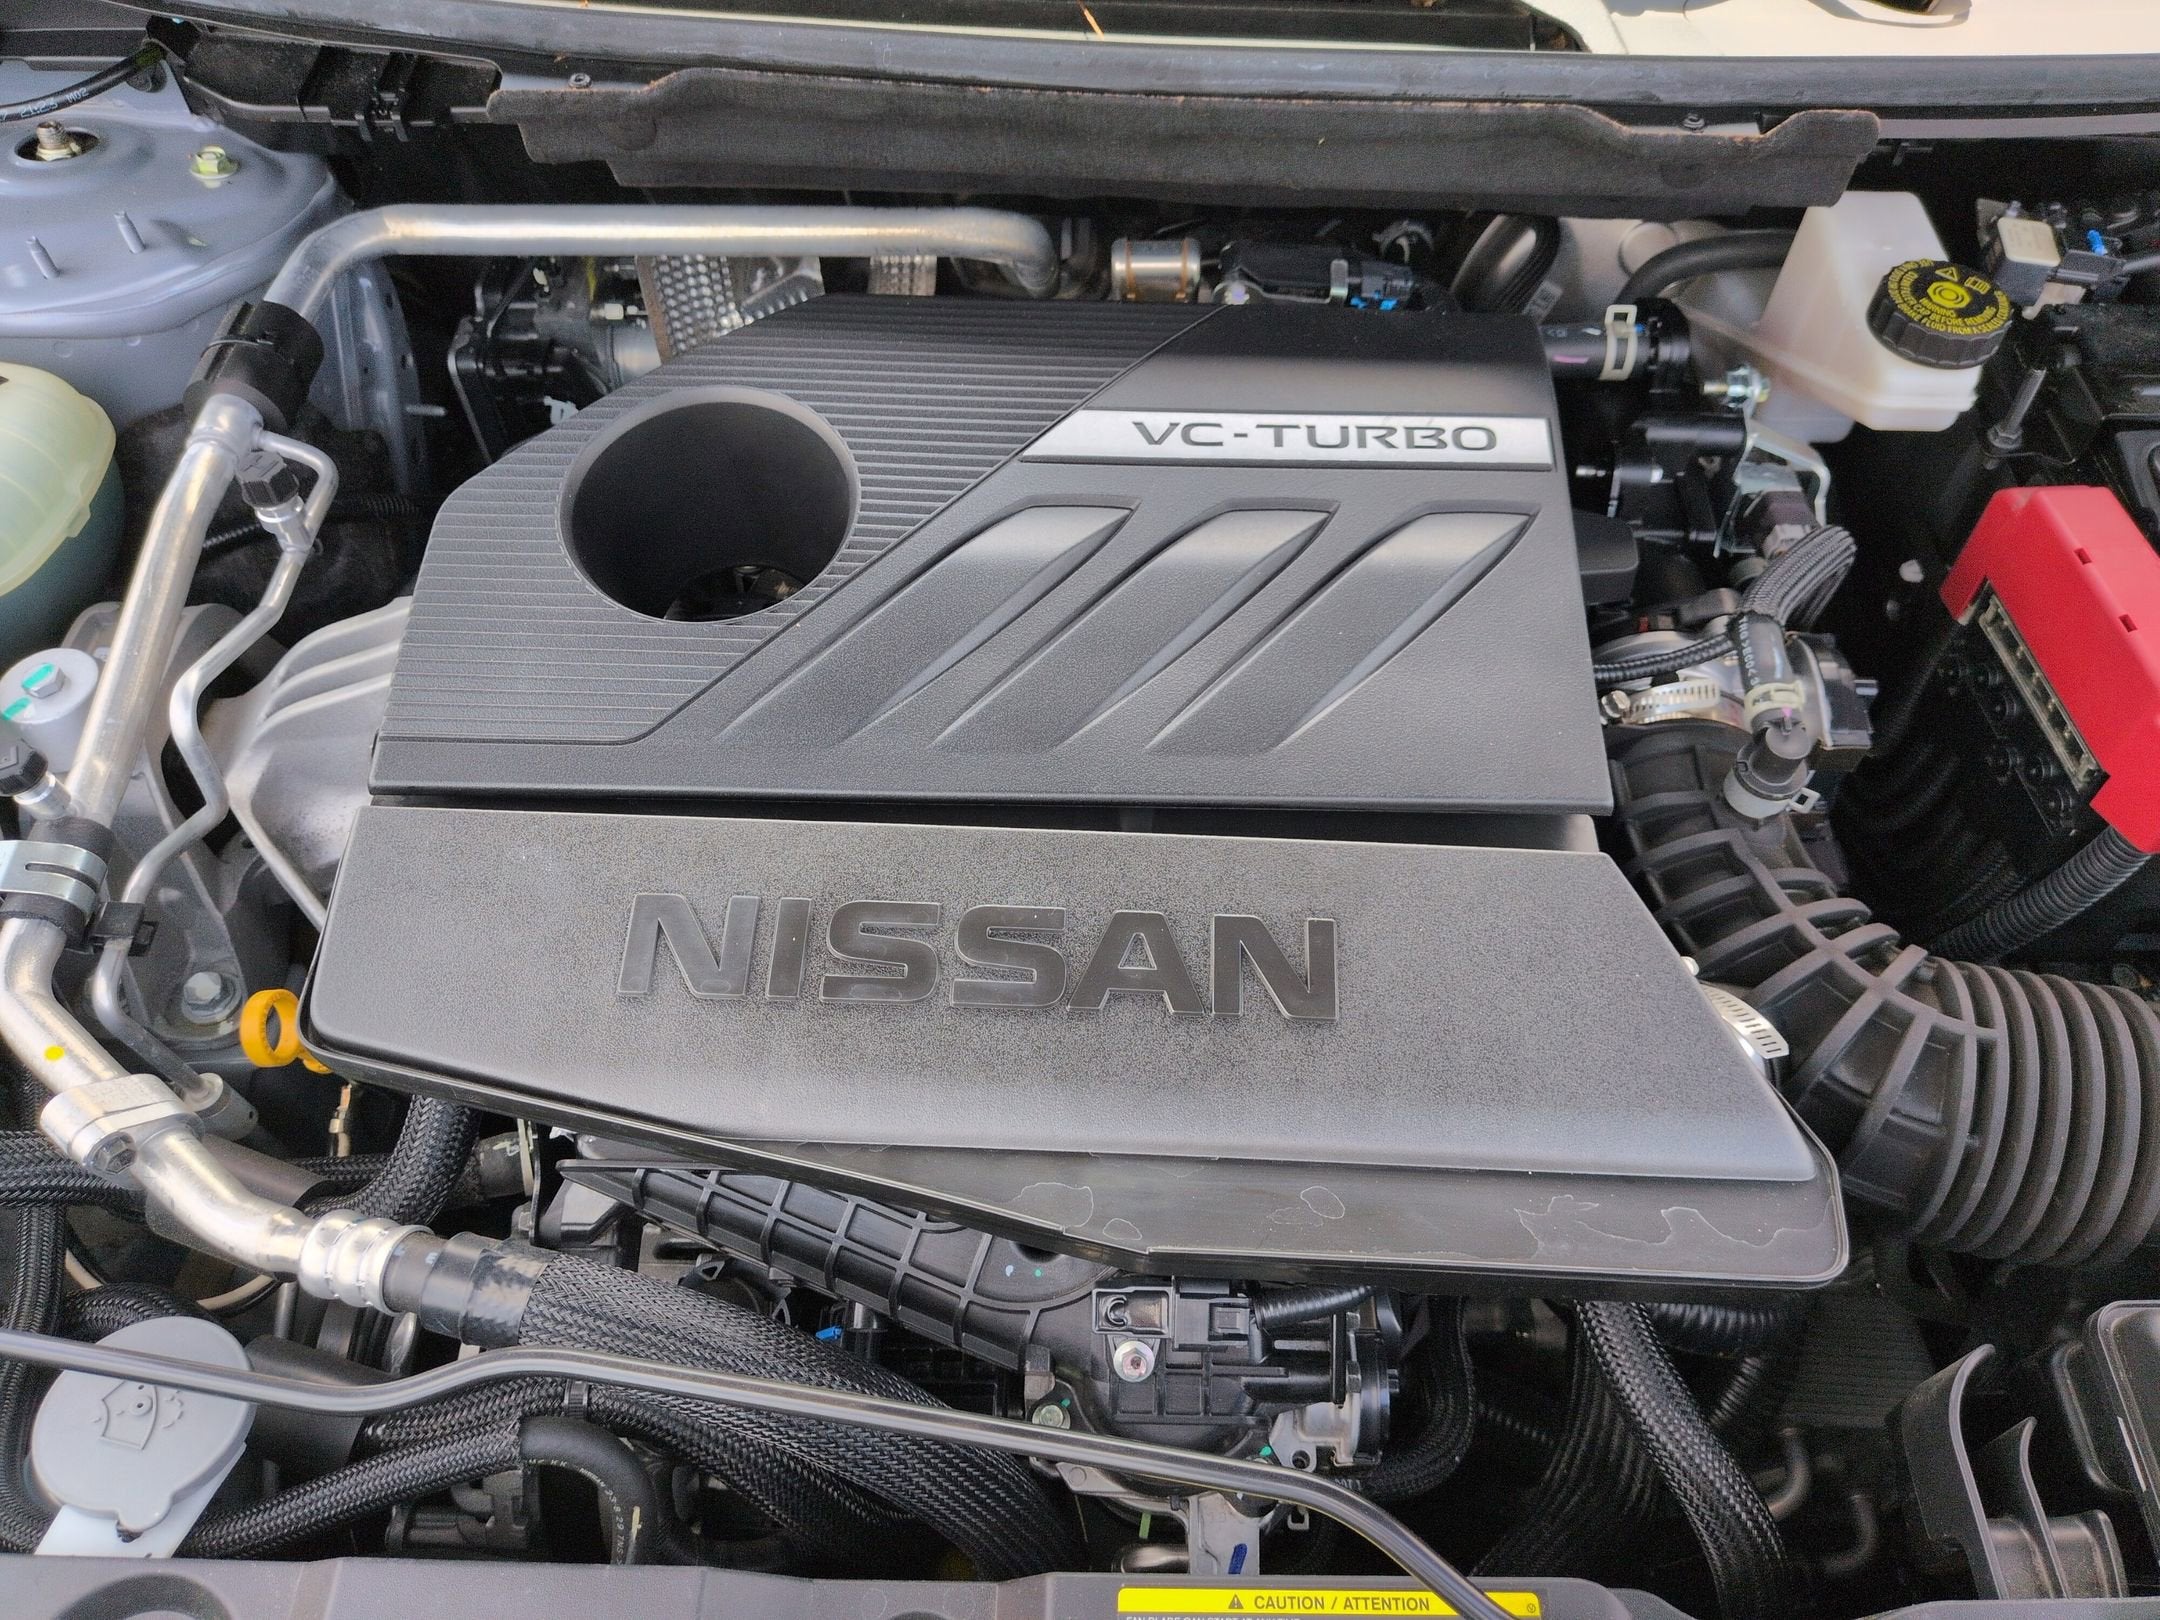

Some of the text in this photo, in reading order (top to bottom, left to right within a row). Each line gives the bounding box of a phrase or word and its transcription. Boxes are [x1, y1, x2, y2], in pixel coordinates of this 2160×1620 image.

[1913, 304, 1932, 316] CAP
[1929, 312, 1965, 326] BEFORE
[1920, 298, 1956, 318] WARNING
[1920, 318, 1947, 332] FLUID
[1947, 326, 1973, 335] FROM
[1132, 421, 1497, 451] VC-TURBO
[616, 893, 1338, 1022] NISSAN
[1254, 1595, 1325, 1610] CAUTION
[1343, 1596, 1430, 1611] ATTENTION
